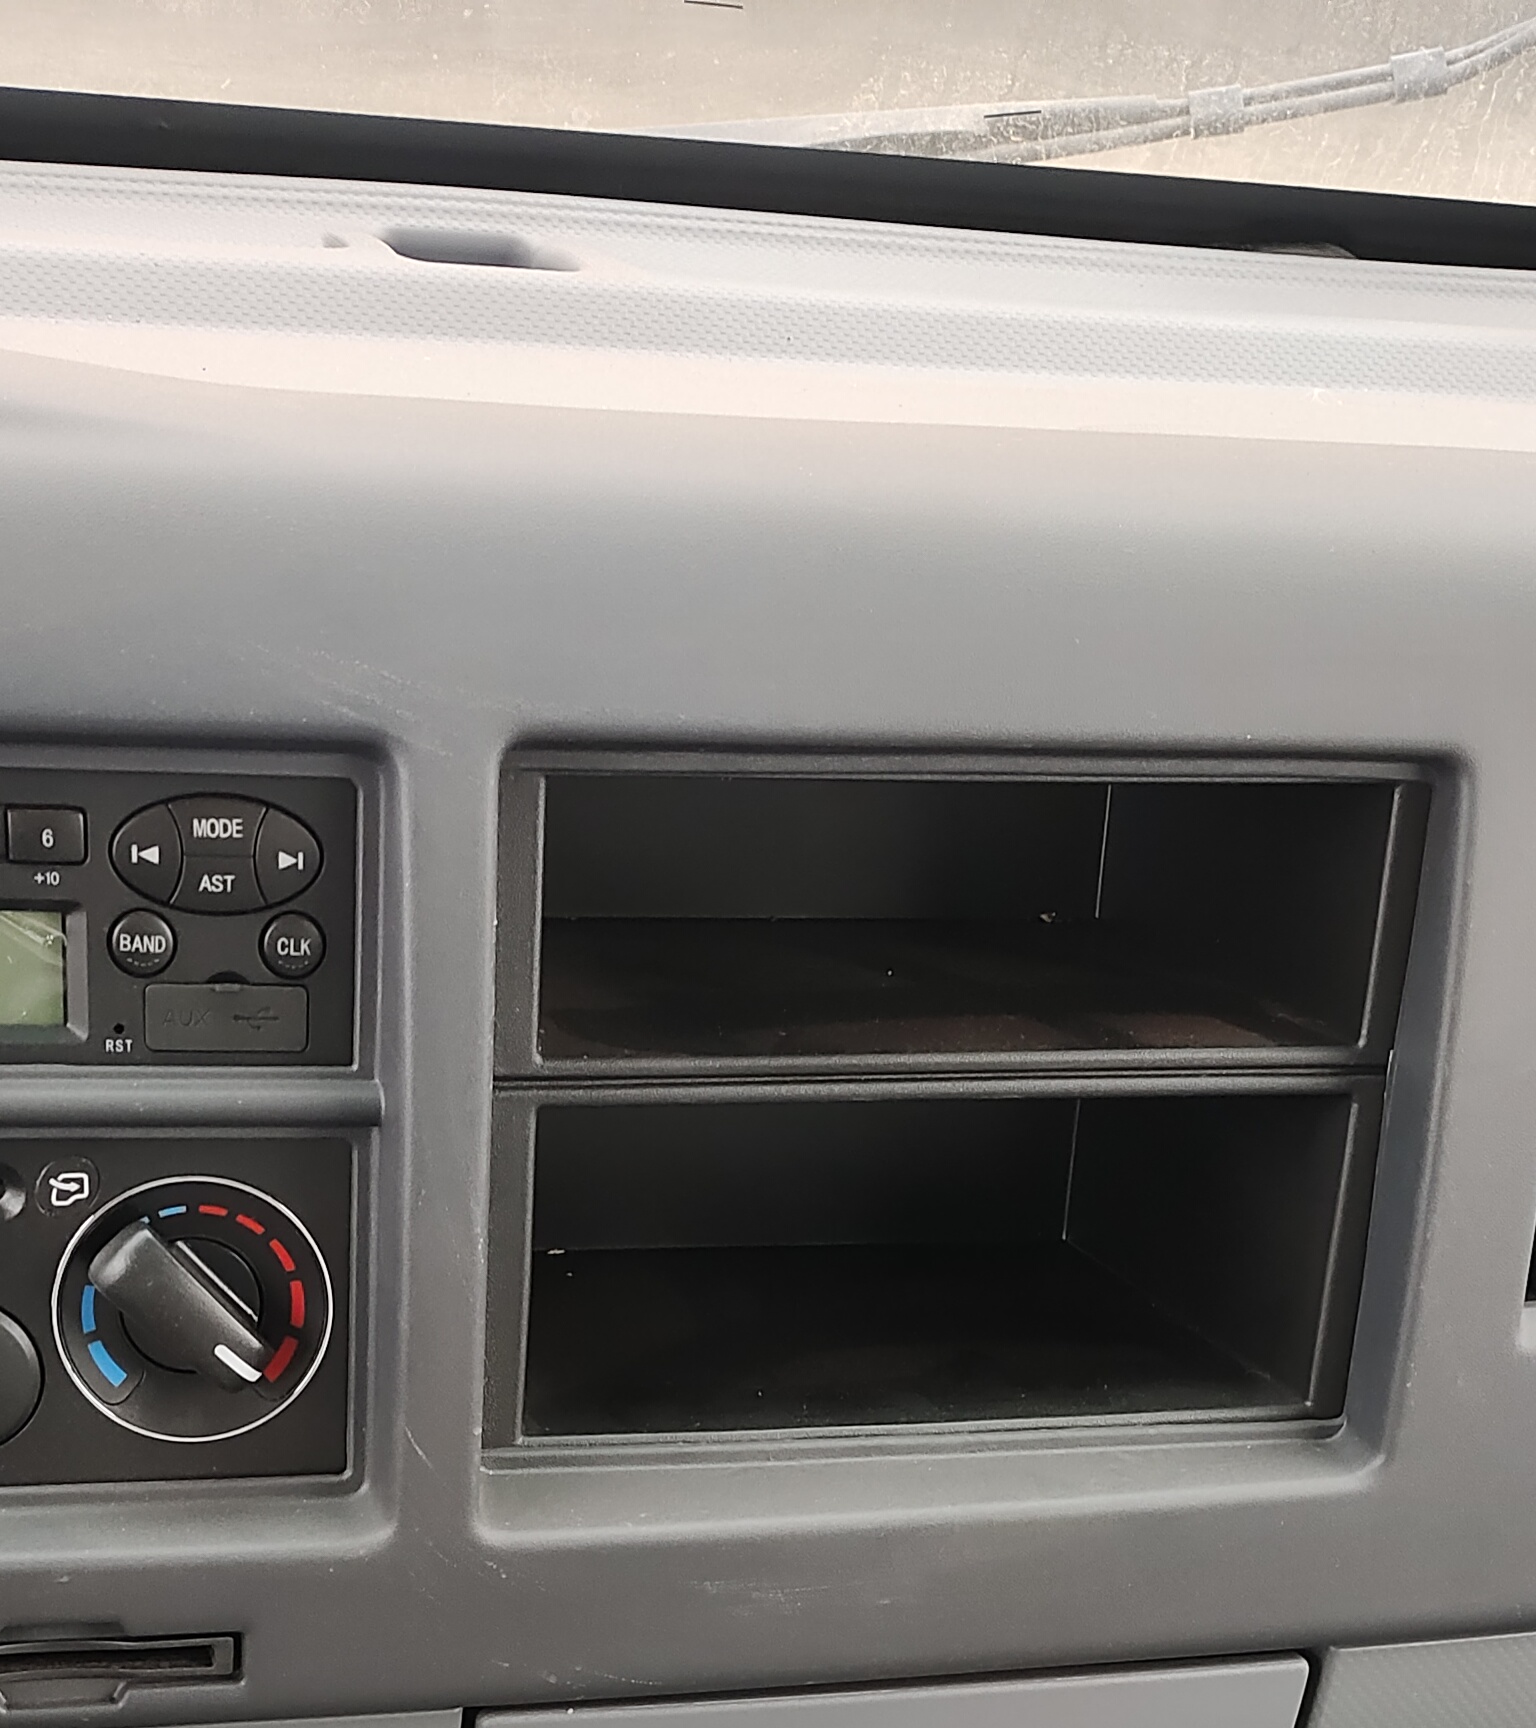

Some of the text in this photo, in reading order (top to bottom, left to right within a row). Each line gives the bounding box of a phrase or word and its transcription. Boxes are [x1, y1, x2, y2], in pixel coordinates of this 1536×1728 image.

[41, 827, 54, 847] 6
[192, 818, 244, 839] MODE
[33, 871, 60, 887] +10
[198, 874, 235, 894] AST
[119, 934, 166, 954] BAND
[276, 937, 312, 956] CLK
[163, 1008, 210, 1027] AUX
[105, 1038, 134, 1054] RST
